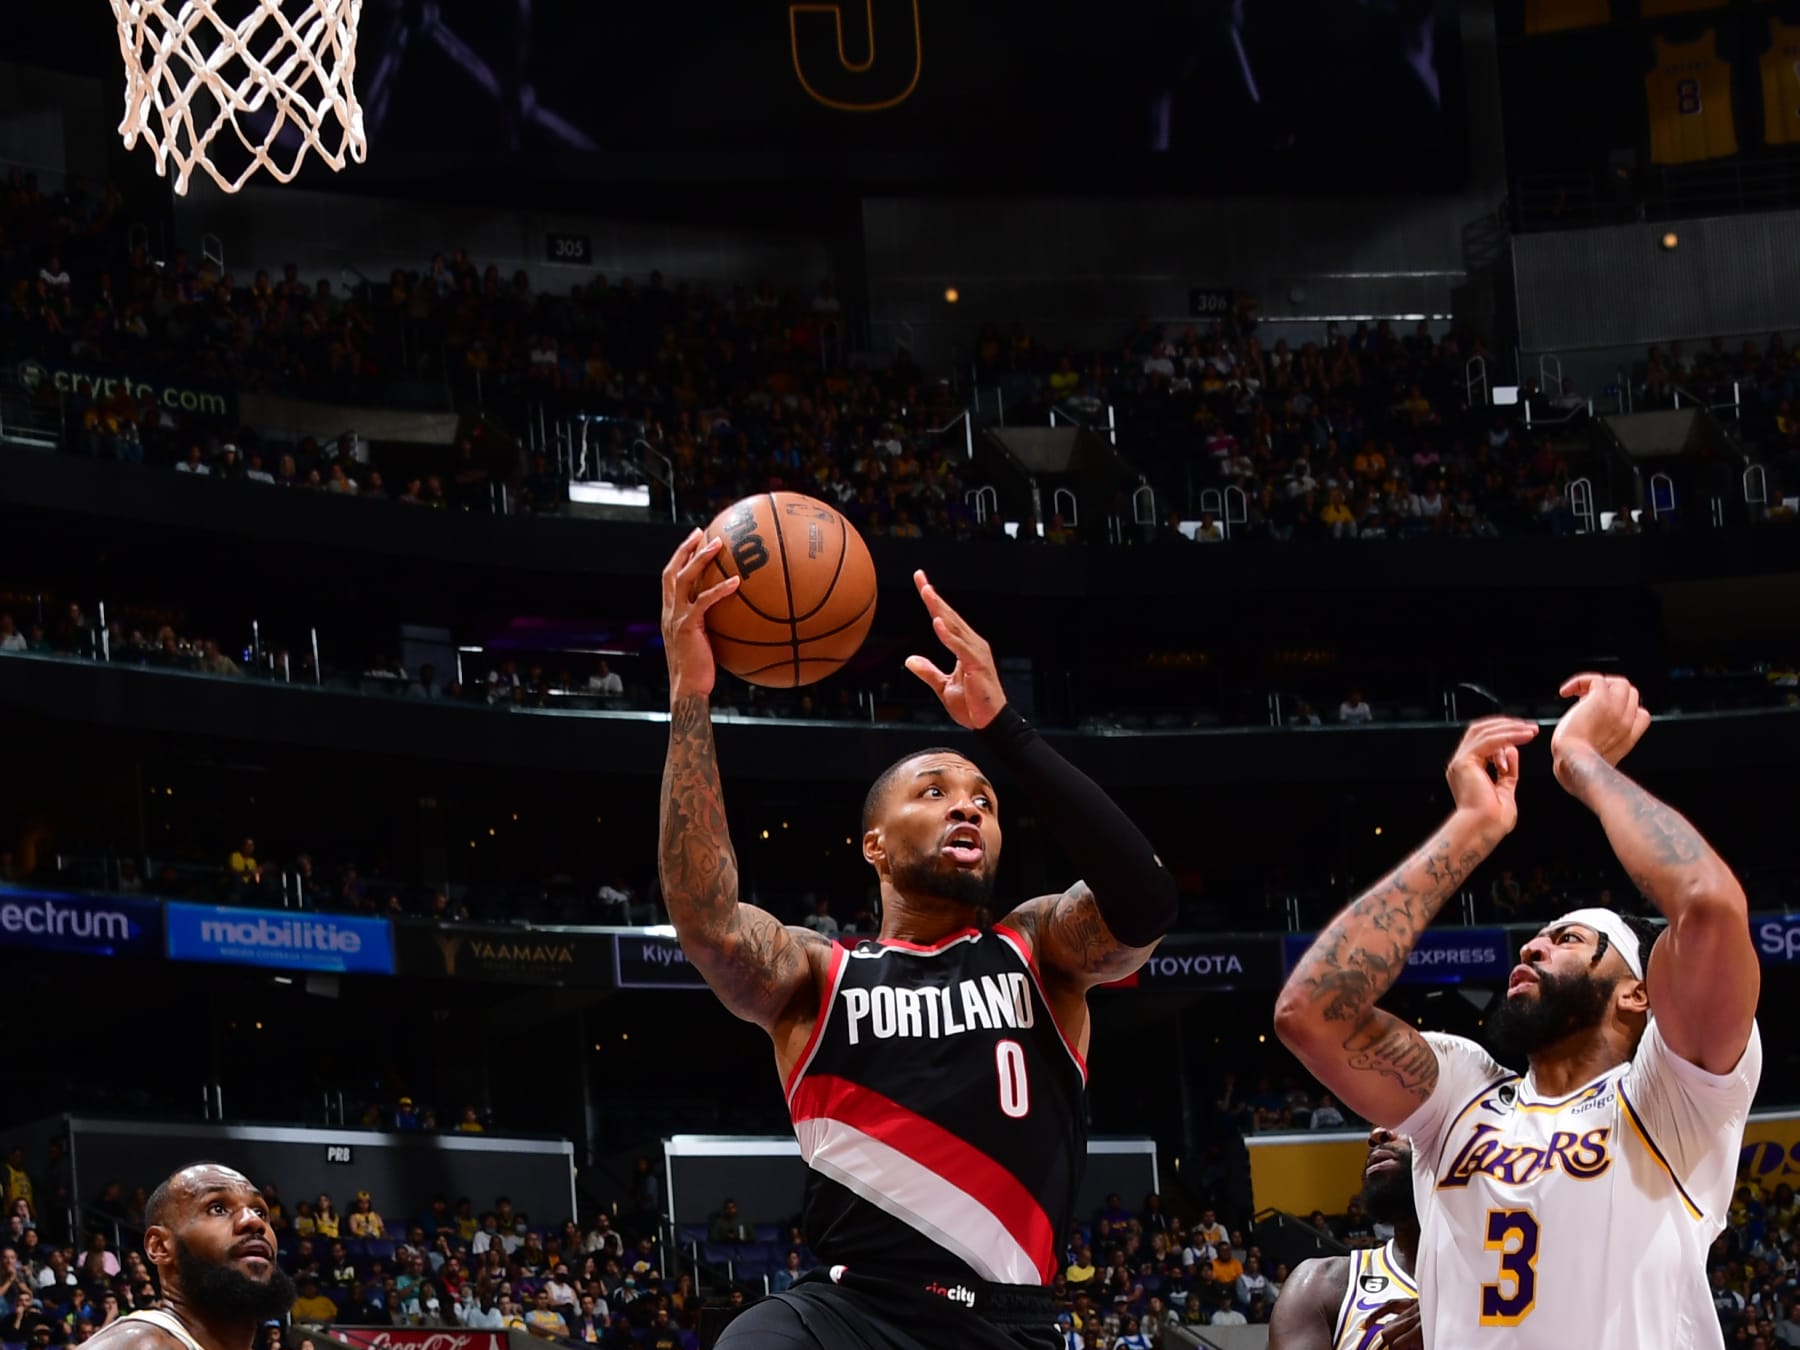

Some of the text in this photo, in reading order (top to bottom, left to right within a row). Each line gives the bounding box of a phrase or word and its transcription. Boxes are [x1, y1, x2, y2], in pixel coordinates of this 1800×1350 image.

[1677, 79, 1703, 117] 8
[555, 240, 584, 257] 305
[0, 900, 129, 940] ectrum
[200, 917, 362, 954] mobilitie
[1148, 953, 1243, 977] TOYOTA
[840, 972, 1035, 1046] PORTLAND
[994, 1036, 1032, 1120] 0
[1571, 1093, 1615, 1115] bibigo
[1480, 1208, 1541, 1327] 3
